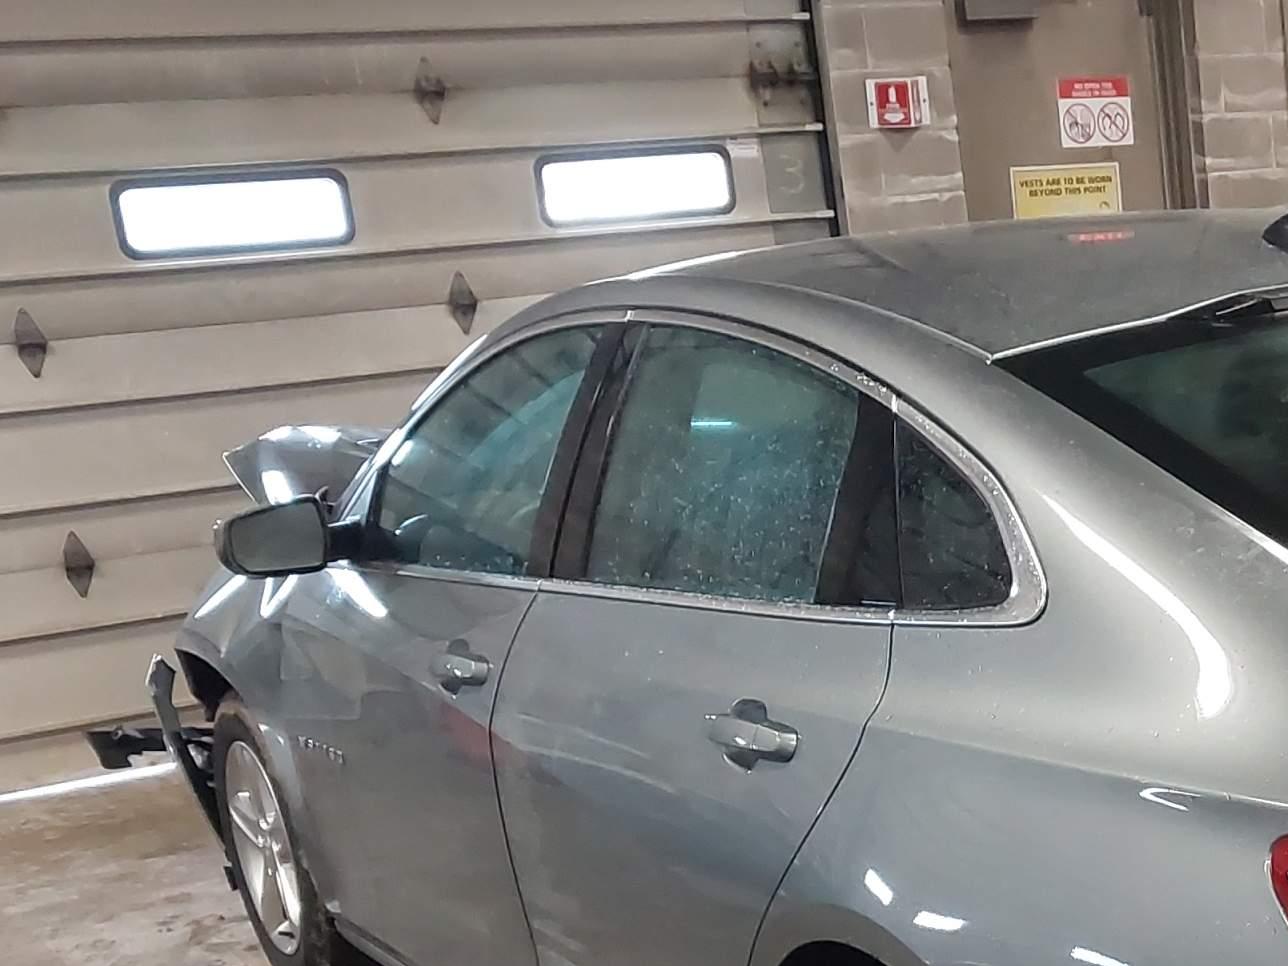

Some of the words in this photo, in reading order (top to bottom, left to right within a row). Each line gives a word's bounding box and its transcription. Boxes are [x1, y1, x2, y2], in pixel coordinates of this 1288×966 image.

[1019, 179, 1044, 188] VESTS
[1046, 178, 1061, 187] ARE
[1064, 176, 1074, 185] TO
[1088, 175, 1113, 184] WORN
[1029, 188, 1062, 198] BEYOND
[1065, 187, 1081, 196] THIS
[1084, 185, 1106, 194] POINT
